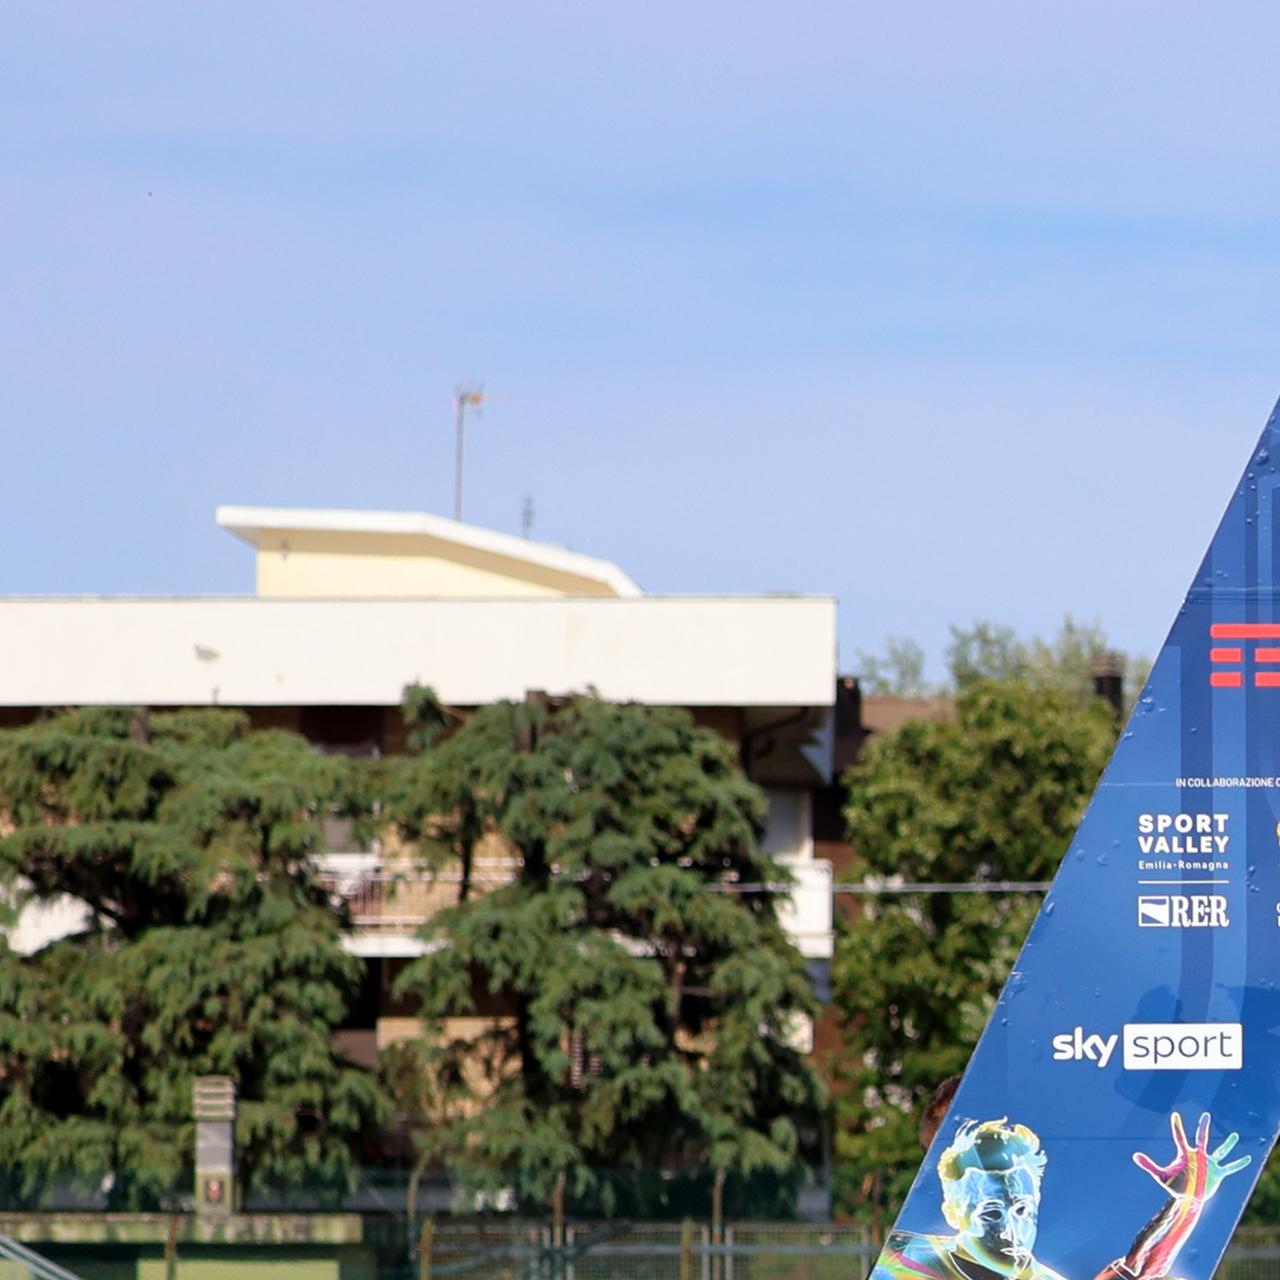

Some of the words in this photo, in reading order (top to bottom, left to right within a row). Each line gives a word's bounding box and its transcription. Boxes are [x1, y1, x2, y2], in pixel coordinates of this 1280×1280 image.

[1176, 778, 1186, 787] IN
[1187, 777, 1274, 788] COLLABORAZIONE
[1138, 814, 1229, 833] SPORT
[1138, 836, 1229, 853] VALLEY
[1052, 1027, 1118, 1068] sky
[1133, 1032, 1233, 1064] sport
